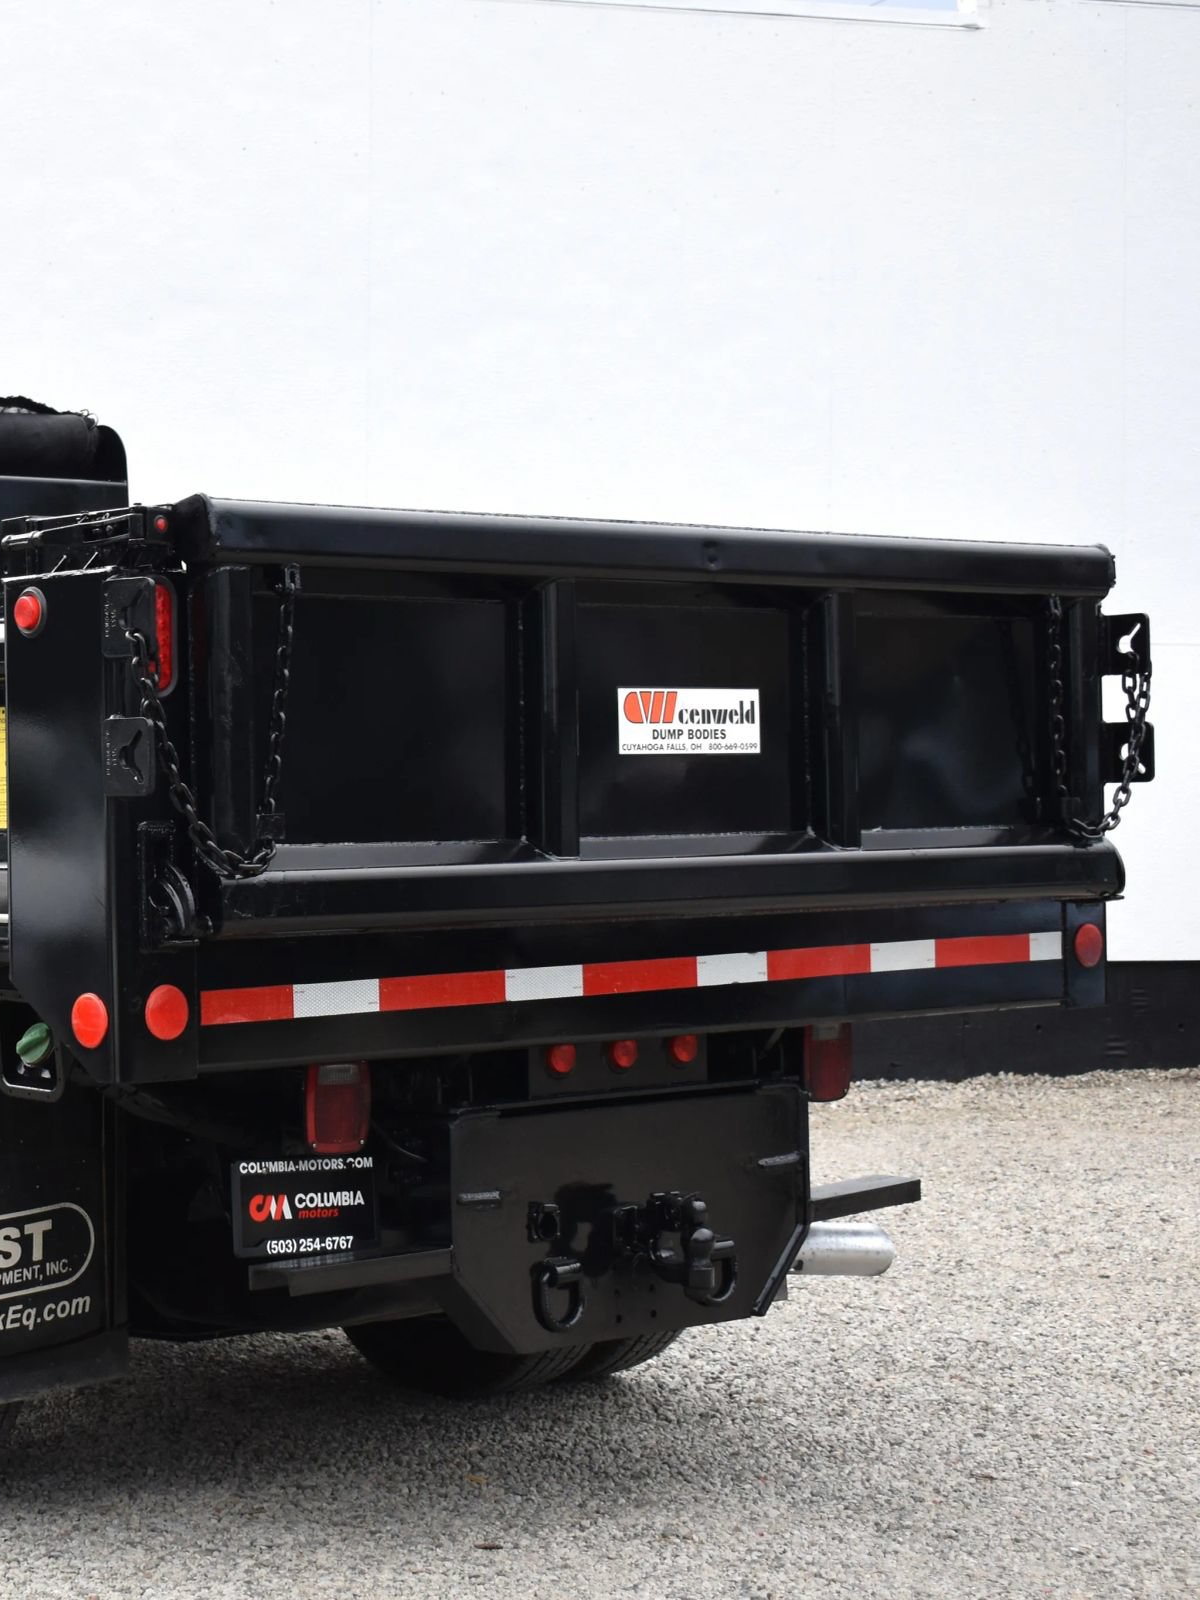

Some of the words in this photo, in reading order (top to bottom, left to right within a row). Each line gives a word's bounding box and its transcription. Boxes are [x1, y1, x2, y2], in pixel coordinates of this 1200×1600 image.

[678, 700, 755, 724] cenweld
[652, 729, 684, 740] DUMP
[688, 729, 727, 740] BODIES
[622, 743, 664, 751] CUYAHOGA
[690, 743, 702, 751] OH
[708, 742, 758, 751] 800-669-0599
[294, 1190, 365, 1209] COLUMBIA
[298, 1208, 339, 1219] motors
[266, 1239, 297, 1254] (503)
[299, 1236, 354, 1252] 254-6767
[46, 1258, 72, 1276] INC.
